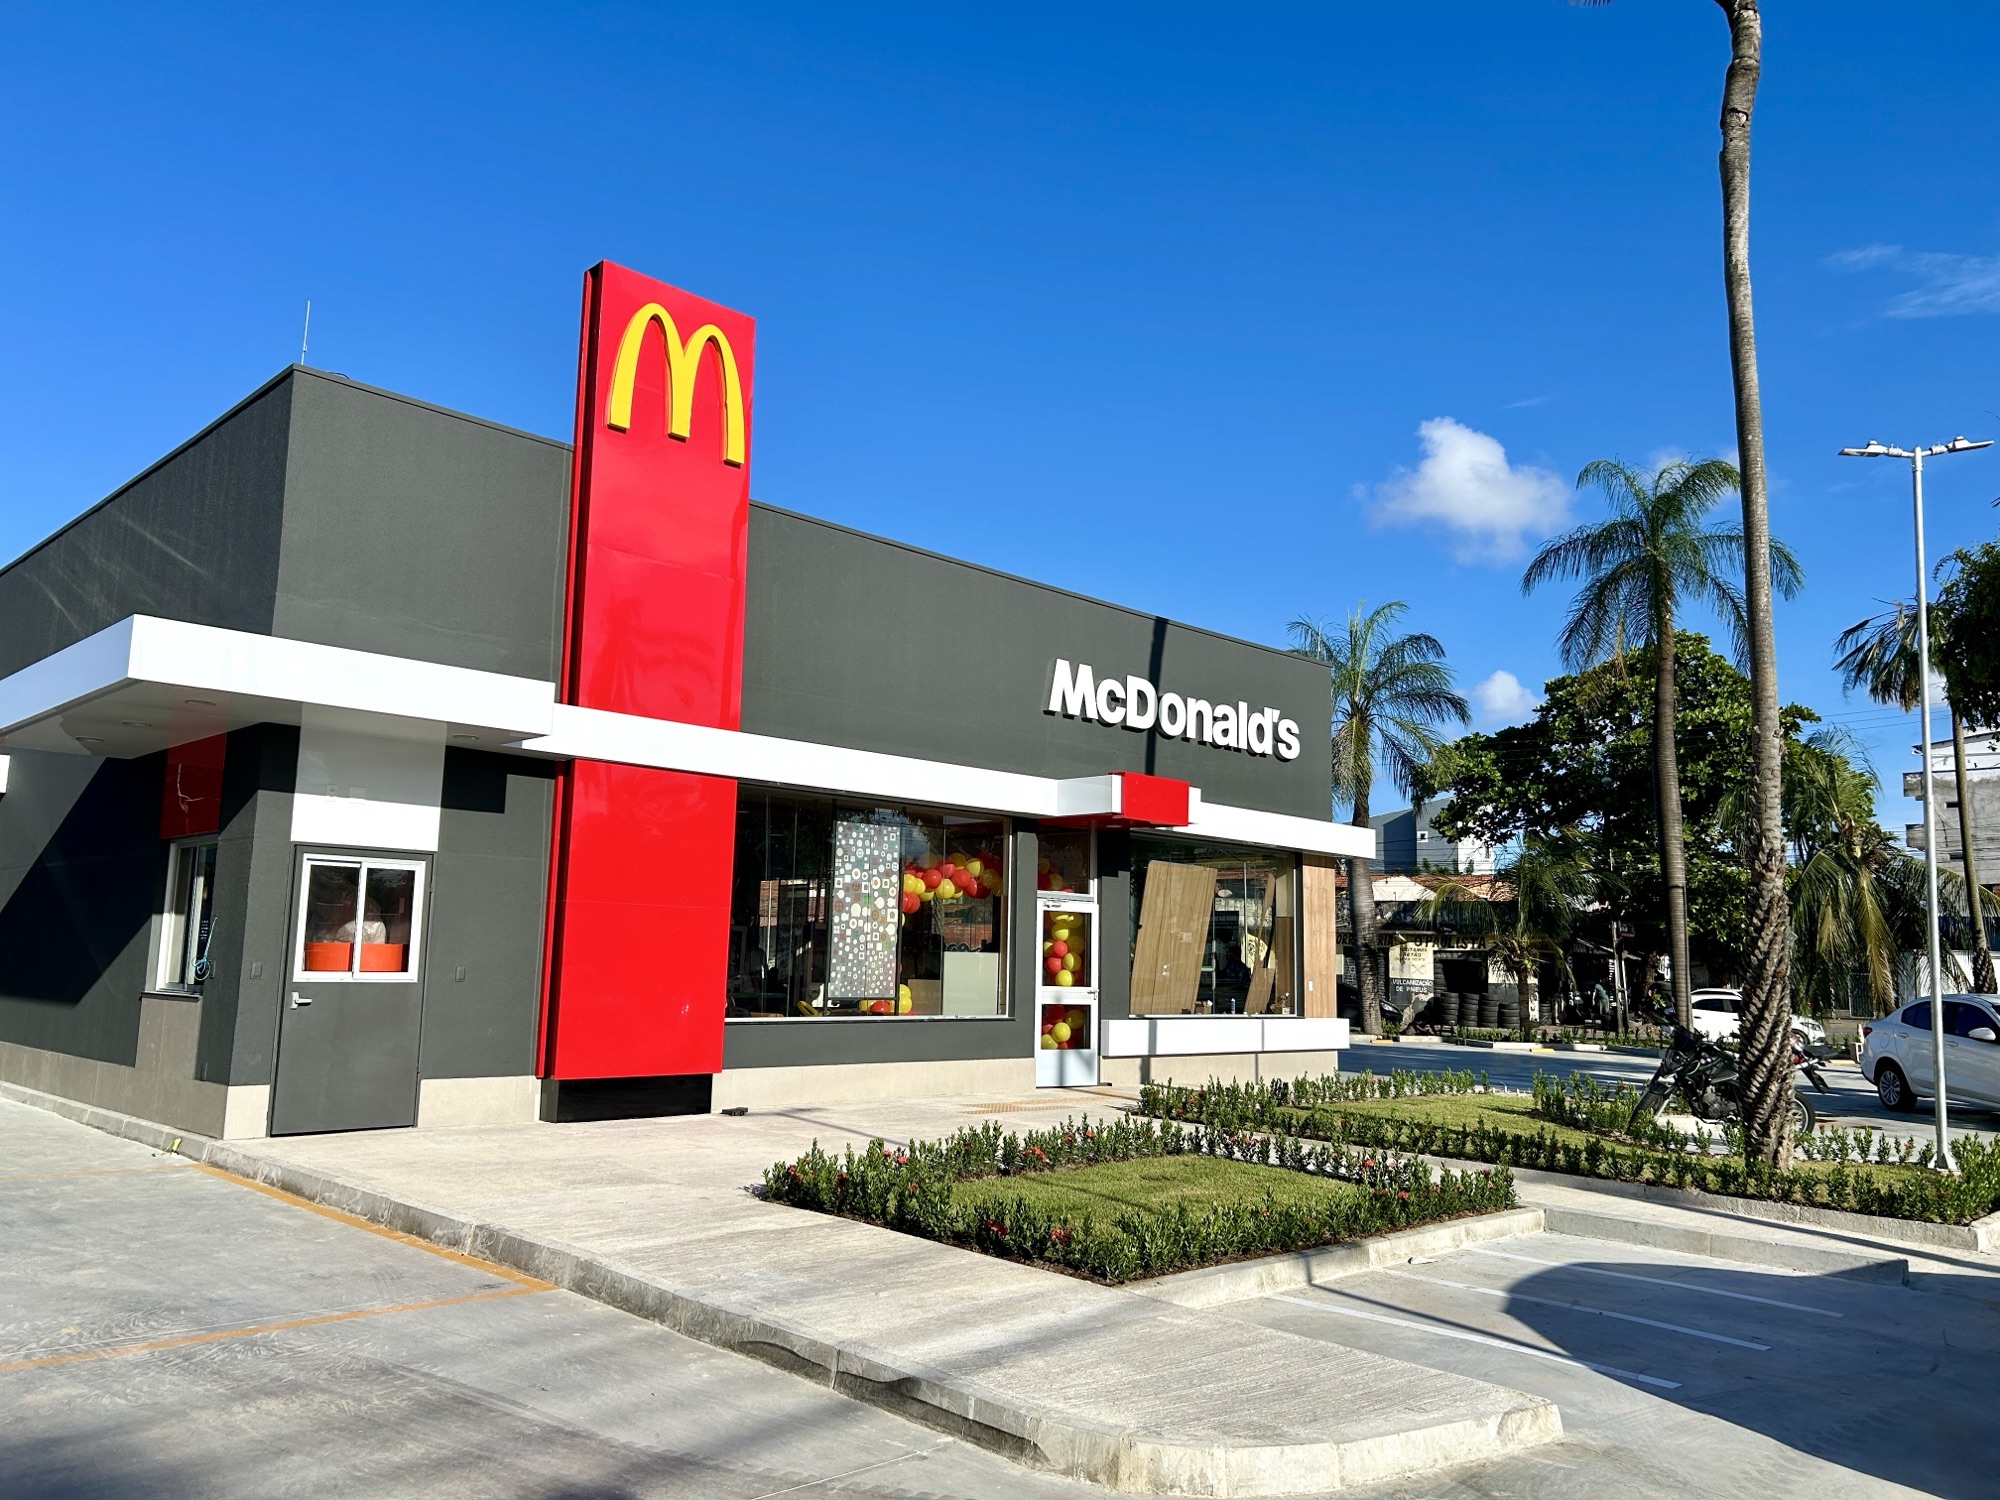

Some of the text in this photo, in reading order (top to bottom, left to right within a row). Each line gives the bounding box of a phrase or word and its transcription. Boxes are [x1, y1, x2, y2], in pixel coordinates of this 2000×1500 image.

[1045, 658, 1301, 761] McDonald's
[1425, 934, 1487, 949] PAULISTA
[1406, 985, 1428, 993] PNEUS
